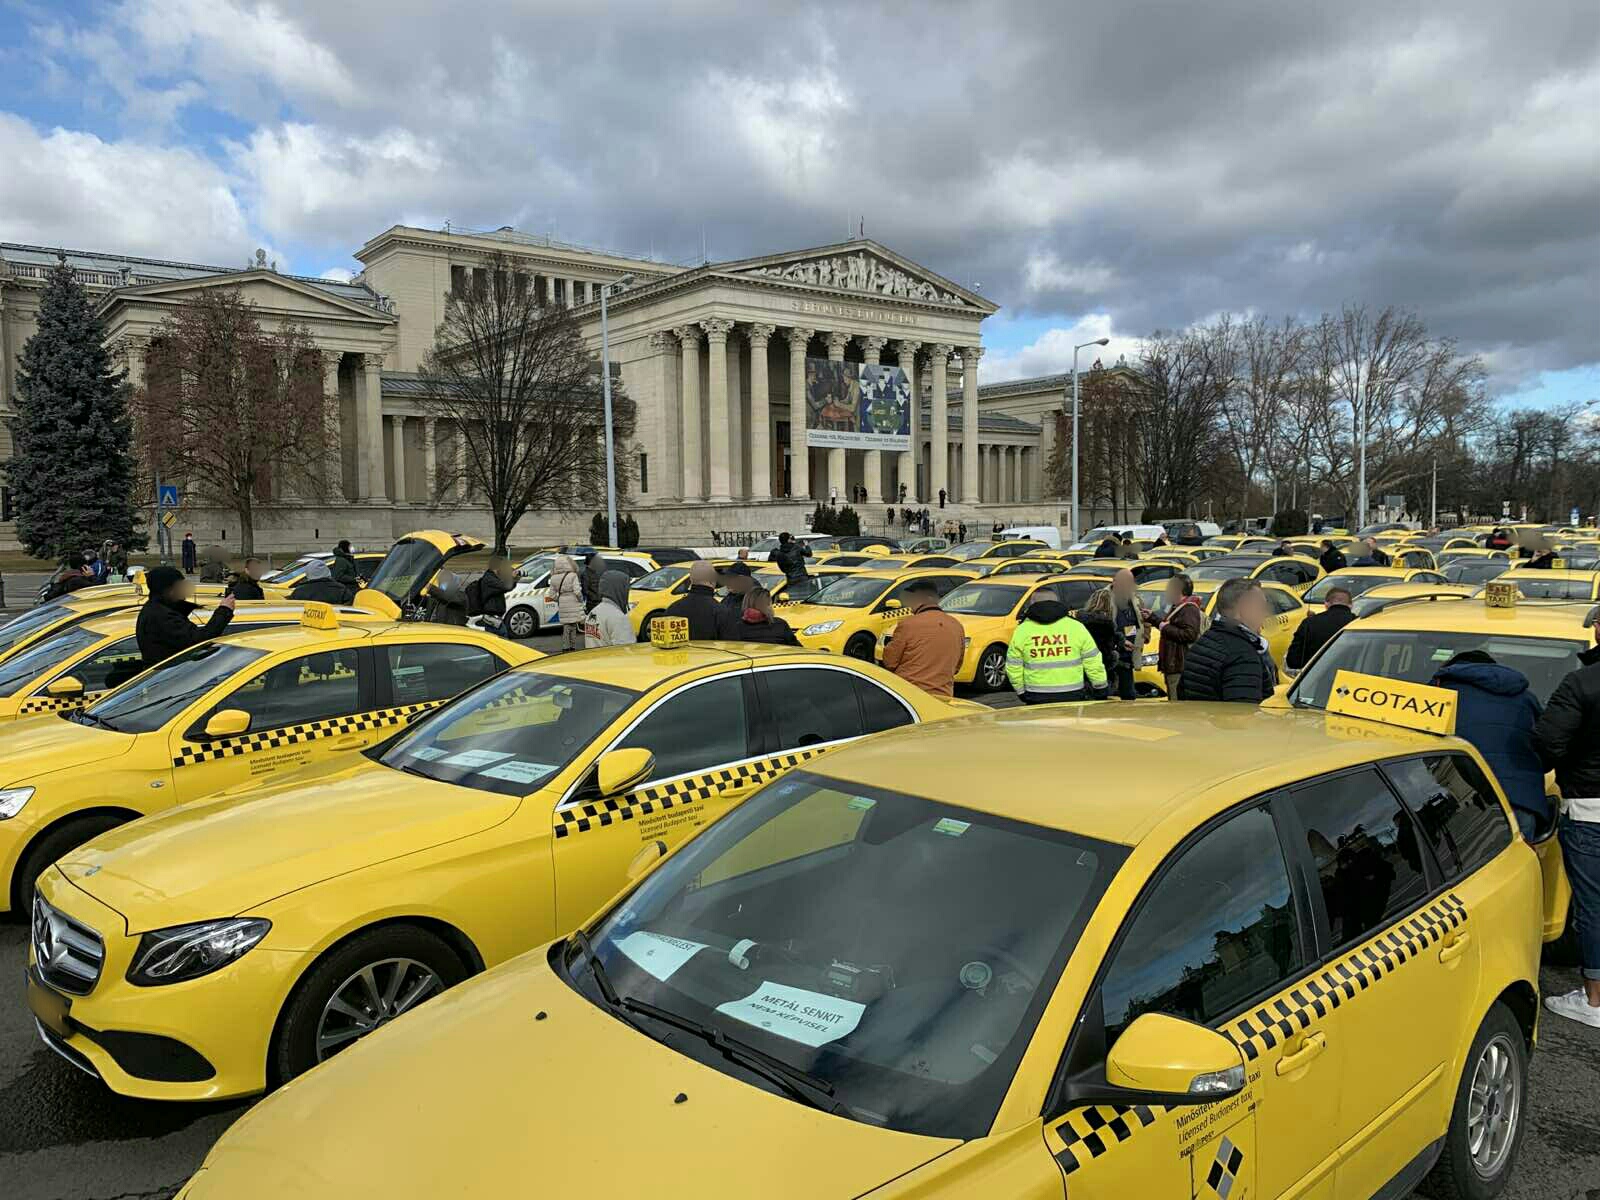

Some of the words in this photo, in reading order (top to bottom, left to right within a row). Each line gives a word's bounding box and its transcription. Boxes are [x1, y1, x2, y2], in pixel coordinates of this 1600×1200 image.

[671, 633, 687, 641] TAXI
[1032, 634, 1067, 646] TAXI
[1030, 646, 1071, 658] STAFF
[1353, 687, 1445, 717] GOTAXI
[750, 1003, 777, 1014] NEM
[761, 995, 799, 1011] METÁL
[800, 1006, 844, 1024] SENKIT
[1249, 1071, 1261, 1083] taxi
[1179, 1117, 1208, 1145] Licensed
[1210, 1098, 1240, 1124] Budapest
[1241, 1091, 1253, 1104] taxi
